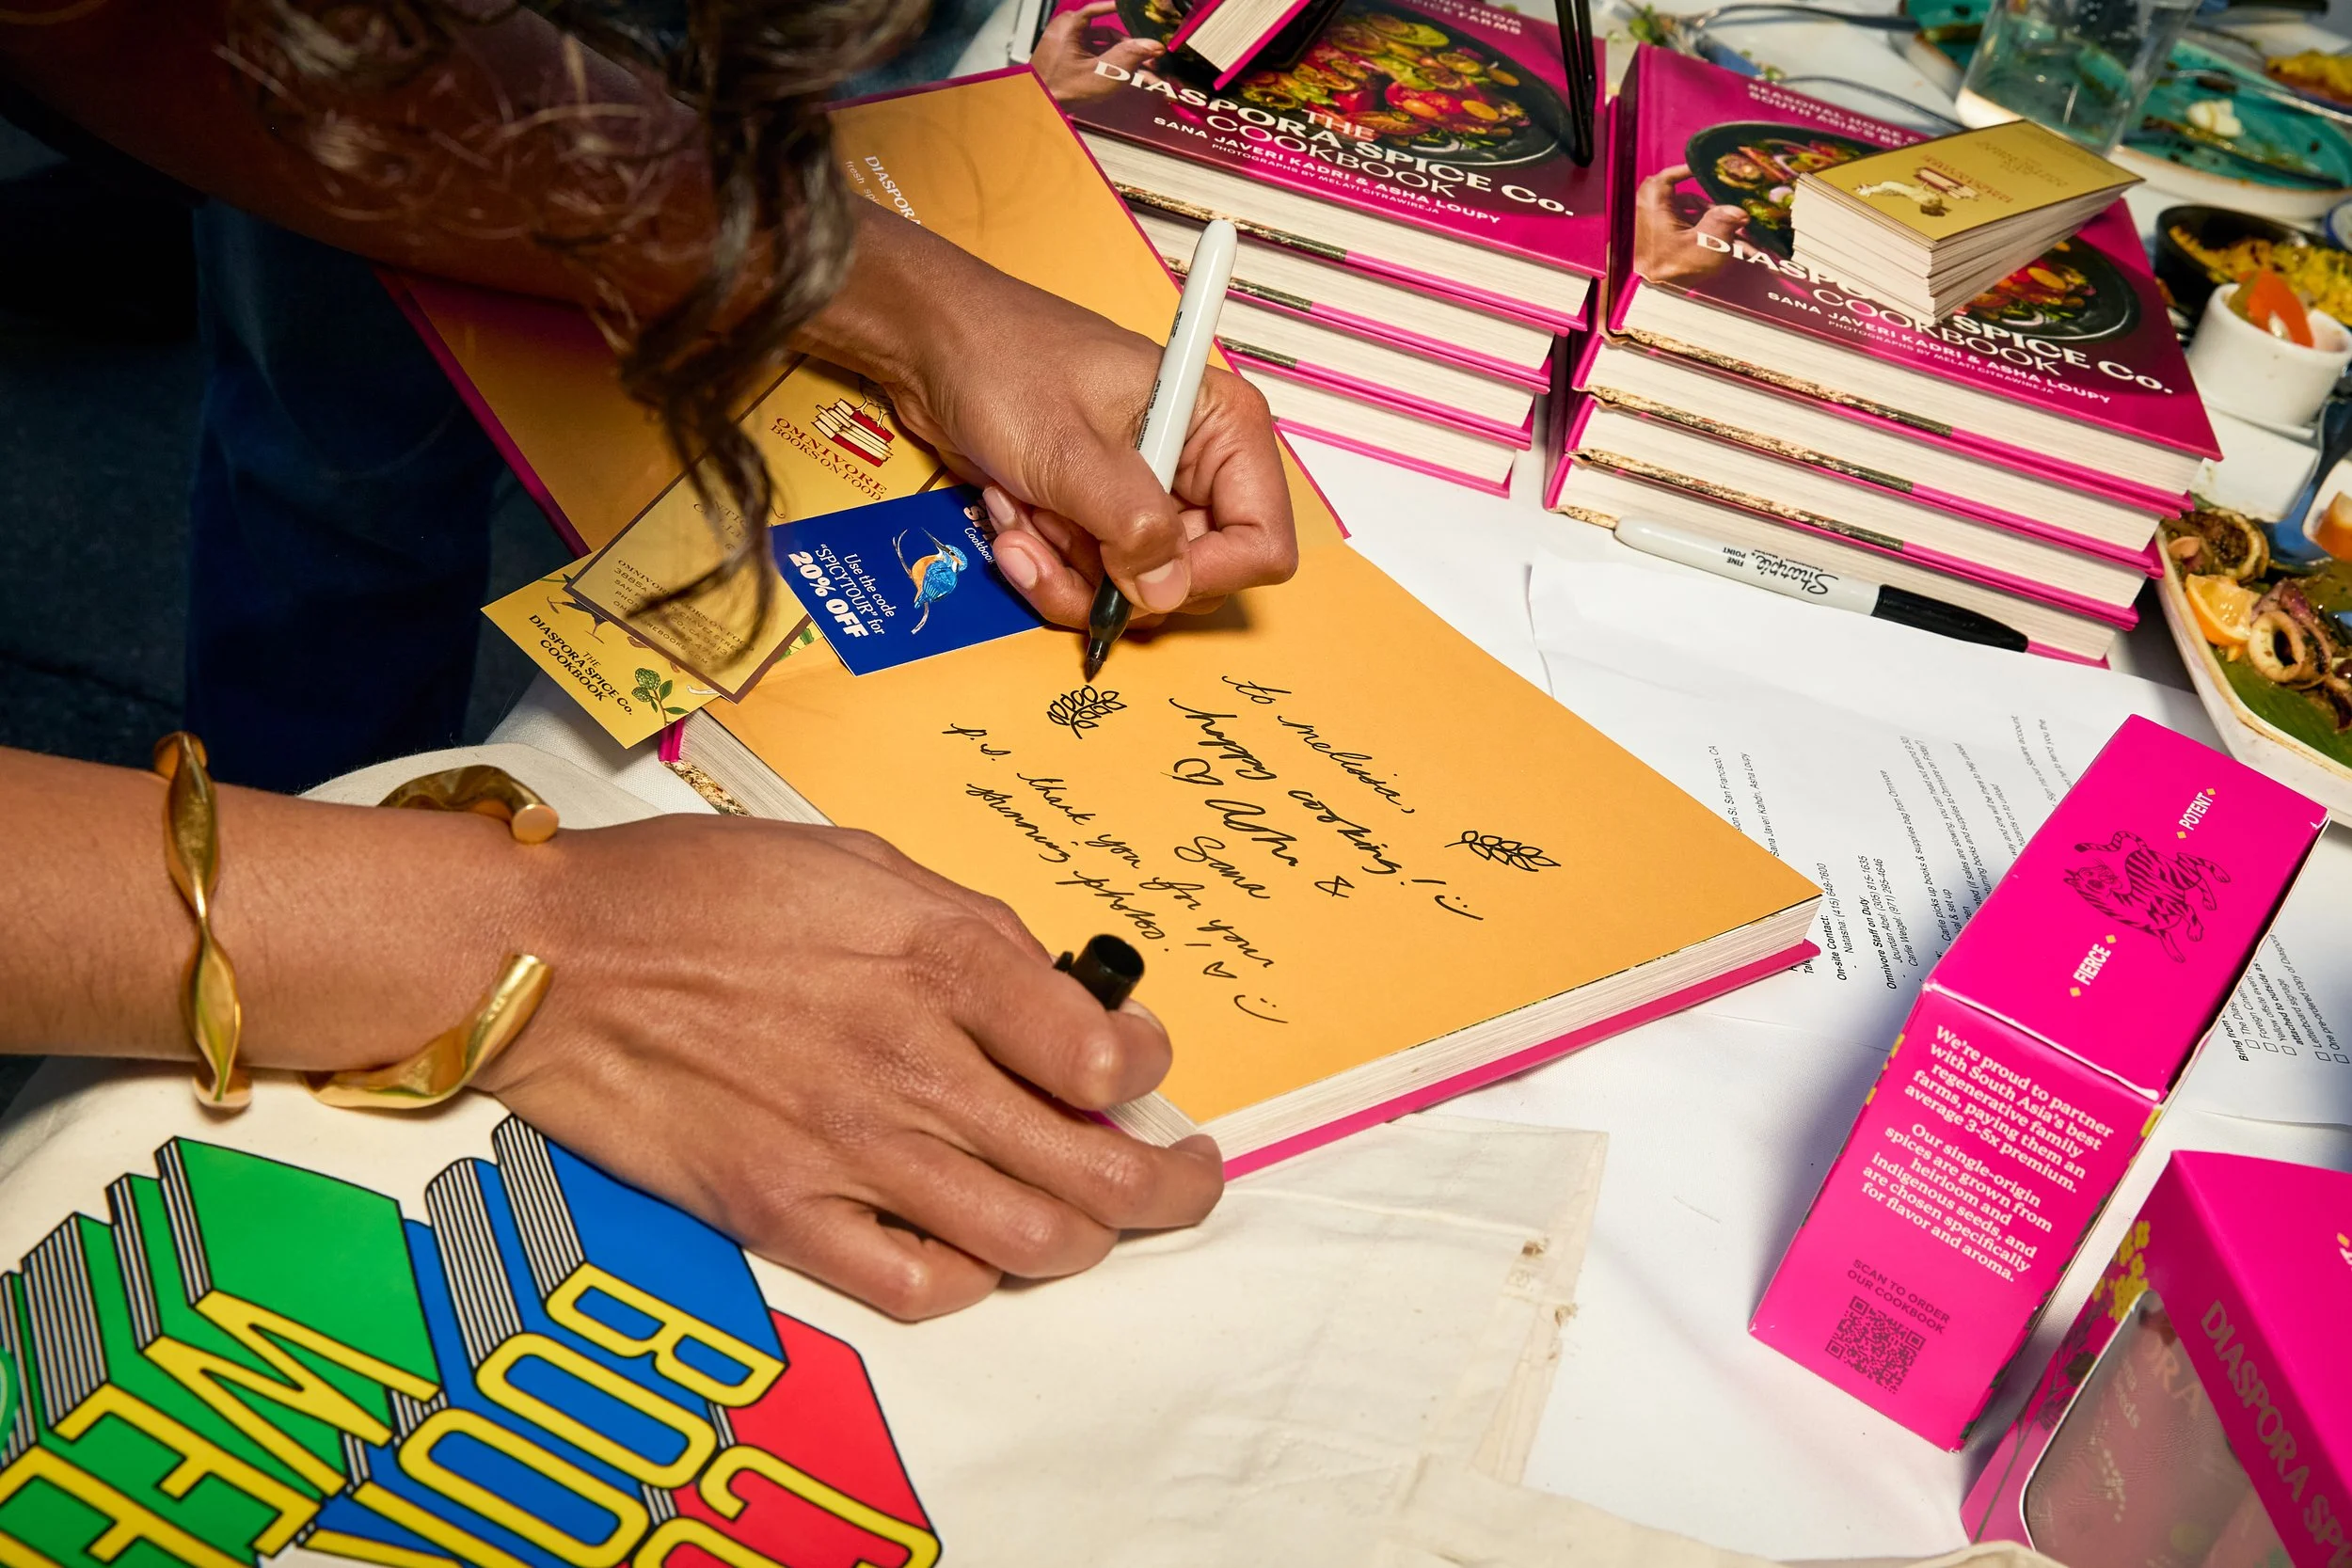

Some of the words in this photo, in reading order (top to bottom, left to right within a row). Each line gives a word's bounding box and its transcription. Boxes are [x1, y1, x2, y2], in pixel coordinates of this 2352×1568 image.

[1094, 61, 1343, 149] DIASPORA
[1355, 140, 1492, 193] SPICE
[1501, 184, 1575, 217] Co.
[1206, 115, 1455, 198] COOKBOOK
[1302, 109, 1375, 142] THE
[845, 160, 865, 185] fresh
[1153, 117, 1208, 139] SANA
[1214, 136, 1284, 161] JAVERI
[1289, 156, 1350, 181] KADRI
[1355, 177, 1369, 187] &
[1375, 182, 1429, 204] ASHA
[1436, 198, 1502, 225] LOUPY
[1212, 144, 1298, 173] PHOTOGRAPHS
[1317, 175, 1360, 193] MELATI
[1767, 292, 1821, 315] SANA
[1828, 312, 1897, 339] JAVERI
[1901, 334, 1963, 359] KADRI
[1967, 355, 1981, 365] &
[1987, 360, 2042, 383] ASHA
[2046, 378, 2111, 404] LOUPY
[1812, 289, 2062, 376] COOKBOOK
[1952, 314, 2091, 370] SPICE
[2098, 360, 2174, 395] Co.
[770, 423, 820, 462] BOOKS
[820, 456, 843, 475] ON
[842, 470, 882, 501] FOOD
[775, 417, 888, 495] OMNIVORE
[617, 560, 671, 595] OMNIVOR
[1722, 546, 1747, 559] POINT
[1725, 556, 1745, 568] FINE
[613, 578, 633, 594] SAN
[787, 550, 836, 597] 20%
[824, 597, 869, 639] OFF
[843, 552, 864, 576] Use
[858, 573, 877, 594] the
[871, 589, 896, 618] code
[866, 617, 885, 636] for
[529, 614, 586, 669] DIASPORA
[584, 667, 619, 699] SPICE
[616, 697, 633, 716] Co.
[540, 639, 608, 702] COOKBOOK
[583, 651, 602, 669] THE
[1221, 675, 1293, 705] to
[1168, 697, 1278, 781] happy
[2178, 791, 2214, 831] POTENT
[1016, 772, 1096, 826] thank
[1084, 833, 1141, 870] you
[1138, 876, 1205, 911] for
[1196, 919, 1275, 969] your
[1173, 835, 1271, 899] Sana
[1920, 863, 1932, 885] books
[1928, 887, 1937, 896] up
[1820, 915, 1836, 949] Contact:
[1829, 898, 1845, 917] (415)
[1837, 919, 1853, 953] Natasha:
[1859, 895, 1871, 915] Duty:
[1867, 918, 1875, 927] on
[1931, 898, 1946, 918] picks
[1832, 952, 1847, 980] On-site
[1868, 928, 1883, 947] Staff
[1878, 950, 1897, 989] Omnivore
[1886, 933, 1903, 963] Jourdan
[2073, 942, 2111, 987] FIERCE
[2222, 1021, 2236, 1037] from
[2233, 1040, 2249, 1061] Bring
[1914, 1070, 1962, 1108] farms,
[1963, 1102, 2019, 1142] paying
[2021, 1134, 2062, 1165] them
[2064, 1162, 2085, 1179] an
[1931, 1044, 1967, 1072] with
[1968, 1066, 2015, 1101] South
[2066, 1122, 2102, 1150] best
[1931, 1064, 2028, 1126] regenerative
[2029, 1121, 2084, 1158] family
[1979, 1056, 2030, 1090] proud
[2031, 1085, 2049, 1101] to
[2048, 1097, 2113, 1137] partner
[1905, 1085, 1963, 1125] average
[1964, 1119, 2000, 1147] 3-5x
[1999, 1142, 2076, 1193] premium.
[1912, 1124, 1943, 1148] Our
[1943, 1145, 2041, 1208] single-origin
[1872, 1152, 1955, 1210] indigenous
[1956, 1206, 2001, 1240] seeds,
[2005, 1235, 2037, 1259] and
[1885, 1128, 1931, 1160] spices
[1933, 1157, 1959, 1176] are
[1958, 1173, 2010, 1208] grown
[2012, 1202, 2052, 1232] from
[1910, 1158, 1979, 1207] heirloom
[1980, 1203, 2012, 1226] and
[1862, 1182, 1886, 1201] for
[1886, 1197, 1931, 1228] flavor
[1931, 1227, 1962, 1248] and
[1962, 1245, 2013, 1282] aroma.
[1863, 1167, 1888, 1186] are
[1889, 1183, 1942, 1220] chosen
[1944, 1216, 2030, 1272] specifically
[1848, 1270, 1873, 1290] OUR
[1875, 1287, 1945, 1334] COOKBOOK
[1853, 1259, 1887, 1285] SCAN
[1890, 1281, 1906, 1295] TO
[1908, 1294, 1949, 1323] ORDER
[2200, 1298, 2311, 1503] DIASPORA
